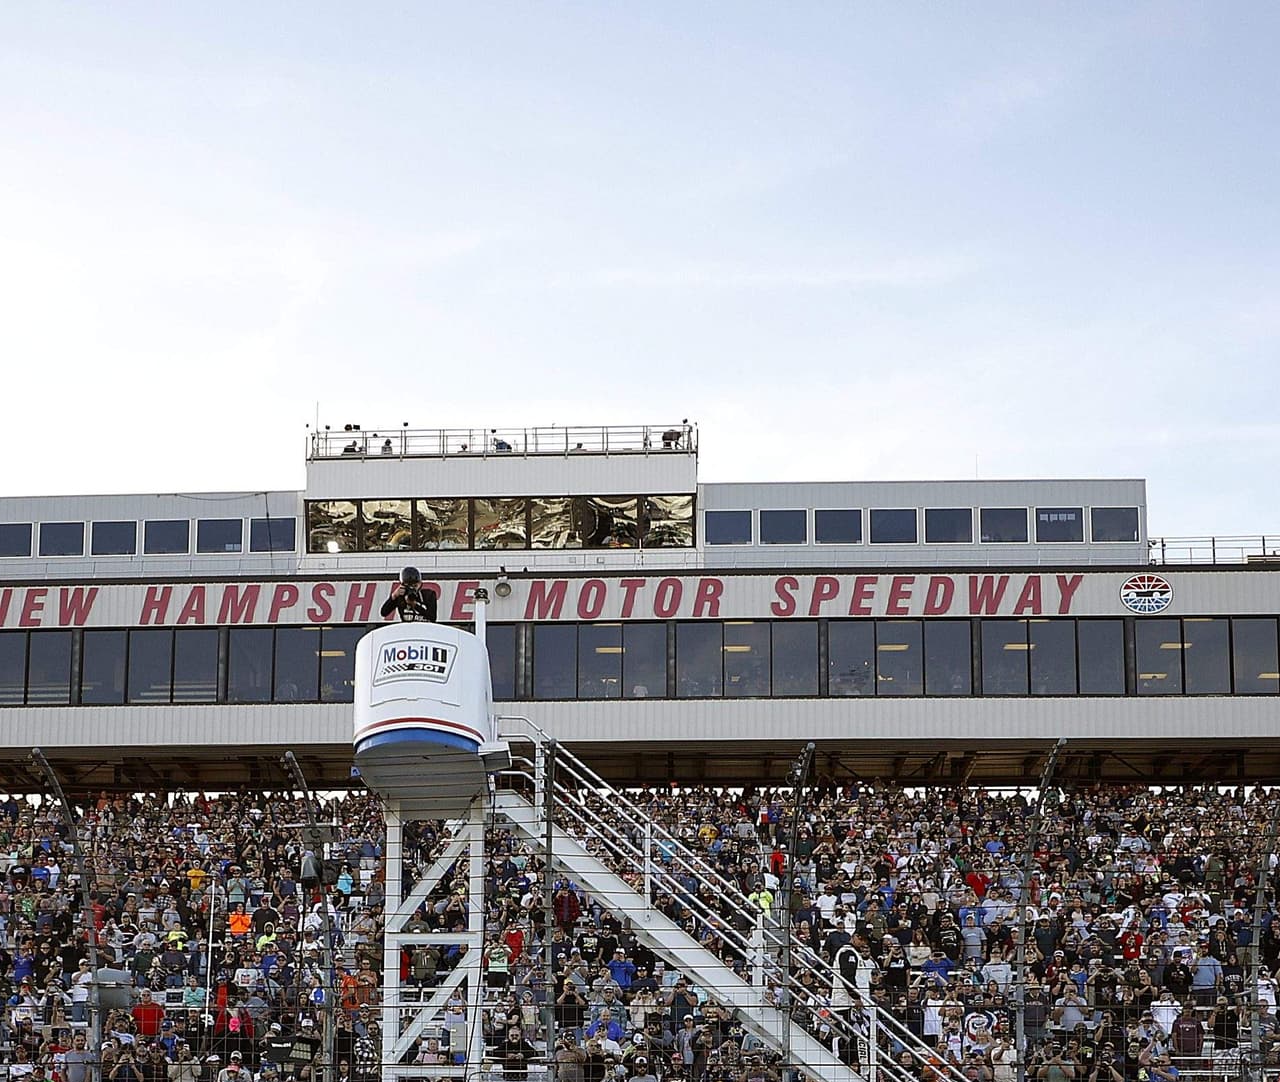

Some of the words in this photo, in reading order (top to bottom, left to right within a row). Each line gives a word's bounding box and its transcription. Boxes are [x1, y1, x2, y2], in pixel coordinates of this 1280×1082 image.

[140, 580, 481, 625] HAMPSHE
[523, 576, 725, 620] MOTOR
[771, 573, 1084, 617] SPEEDWAY
[384, 646, 429, 663] Mobil
[433, 648, 448, 663] 1
